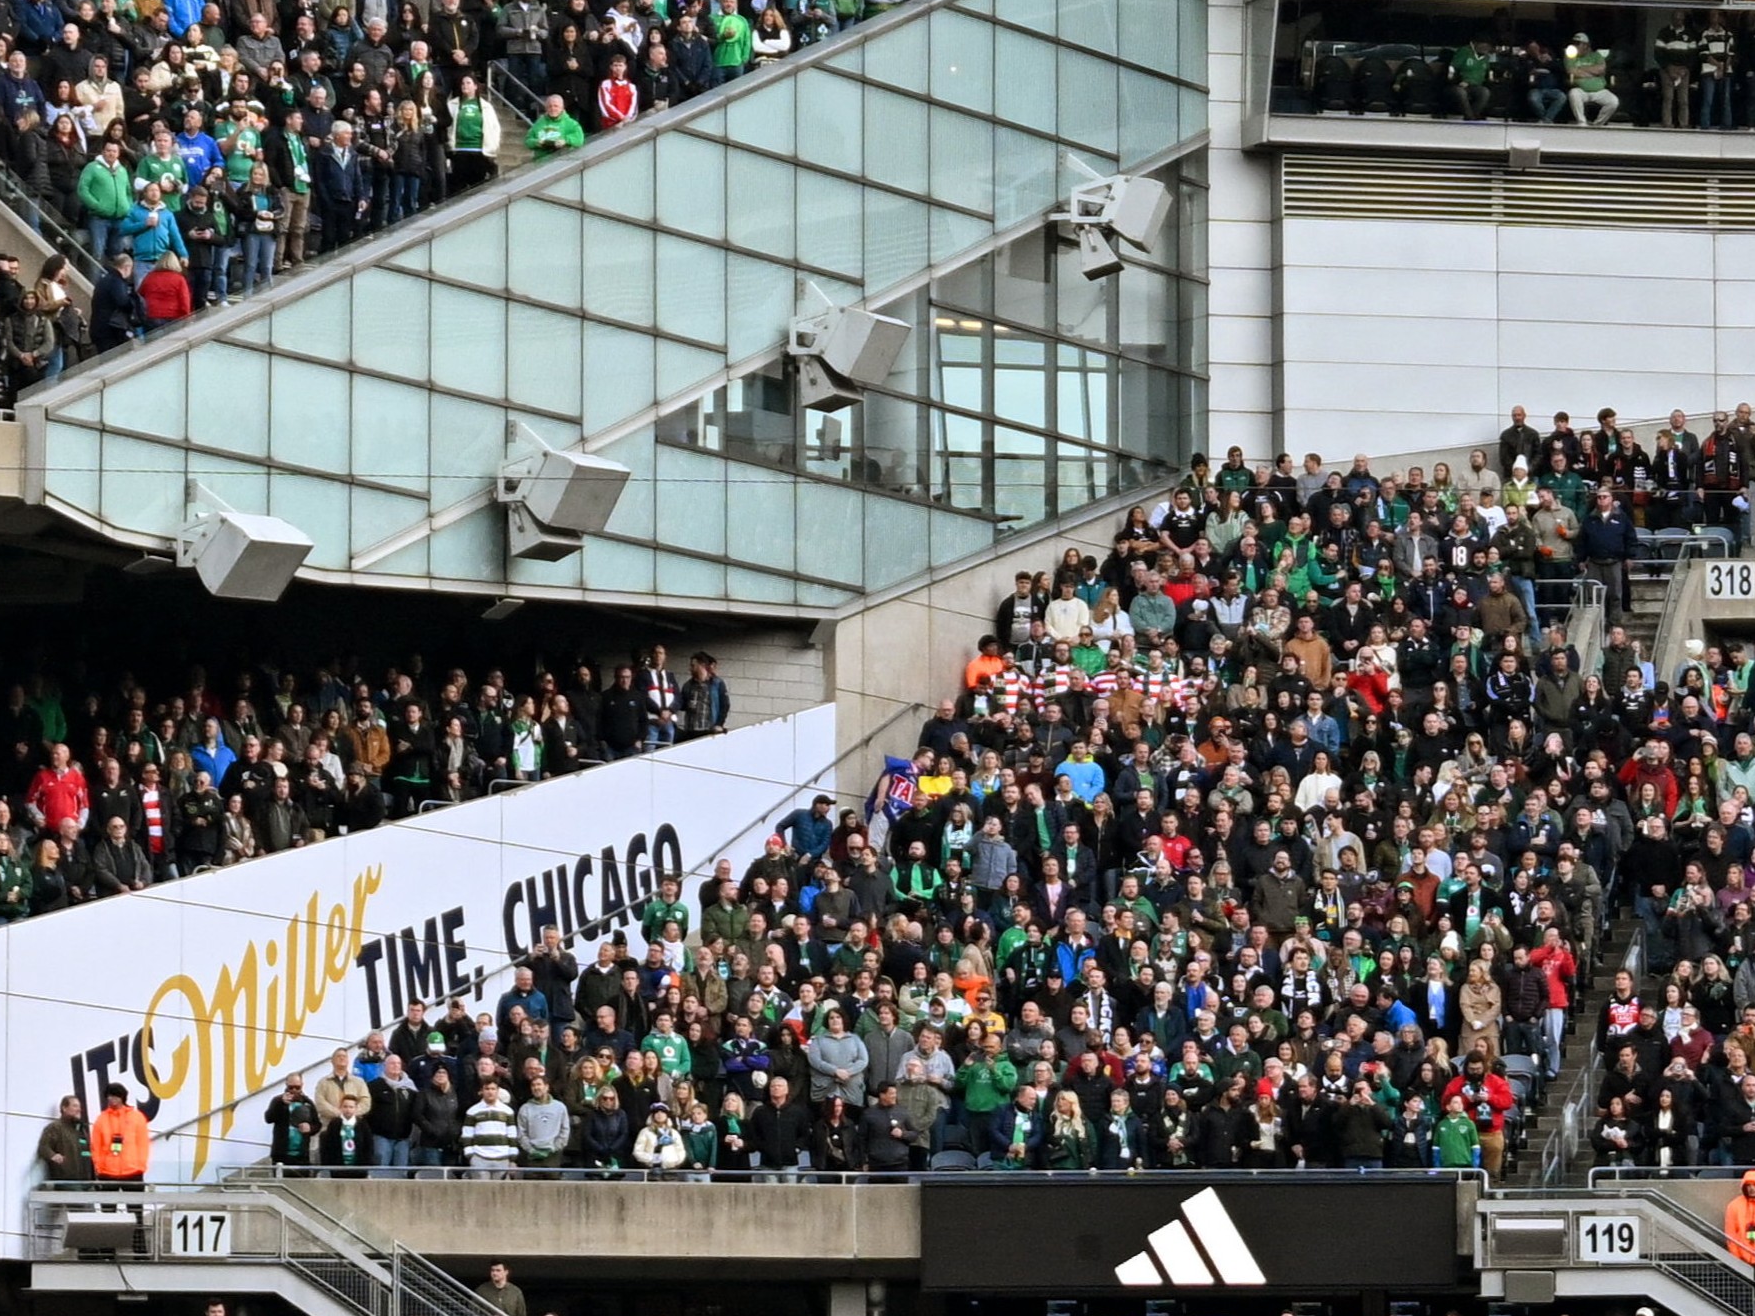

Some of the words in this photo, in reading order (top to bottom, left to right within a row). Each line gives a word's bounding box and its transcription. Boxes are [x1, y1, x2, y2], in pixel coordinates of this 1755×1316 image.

[1452, 547, 1466, 566] 18
[1711, 564, 1754, 597] 318
[71, 1026, 161, 1140] IT'S
[142, 861, 382, 1180] Miller
[356, 905, 484, 1030] TIME,
[503, 822, 684, 961] CHICAGO
[177, 1215, 226, 1252] 117
[1586, 1224, 1635, 1253] 119
